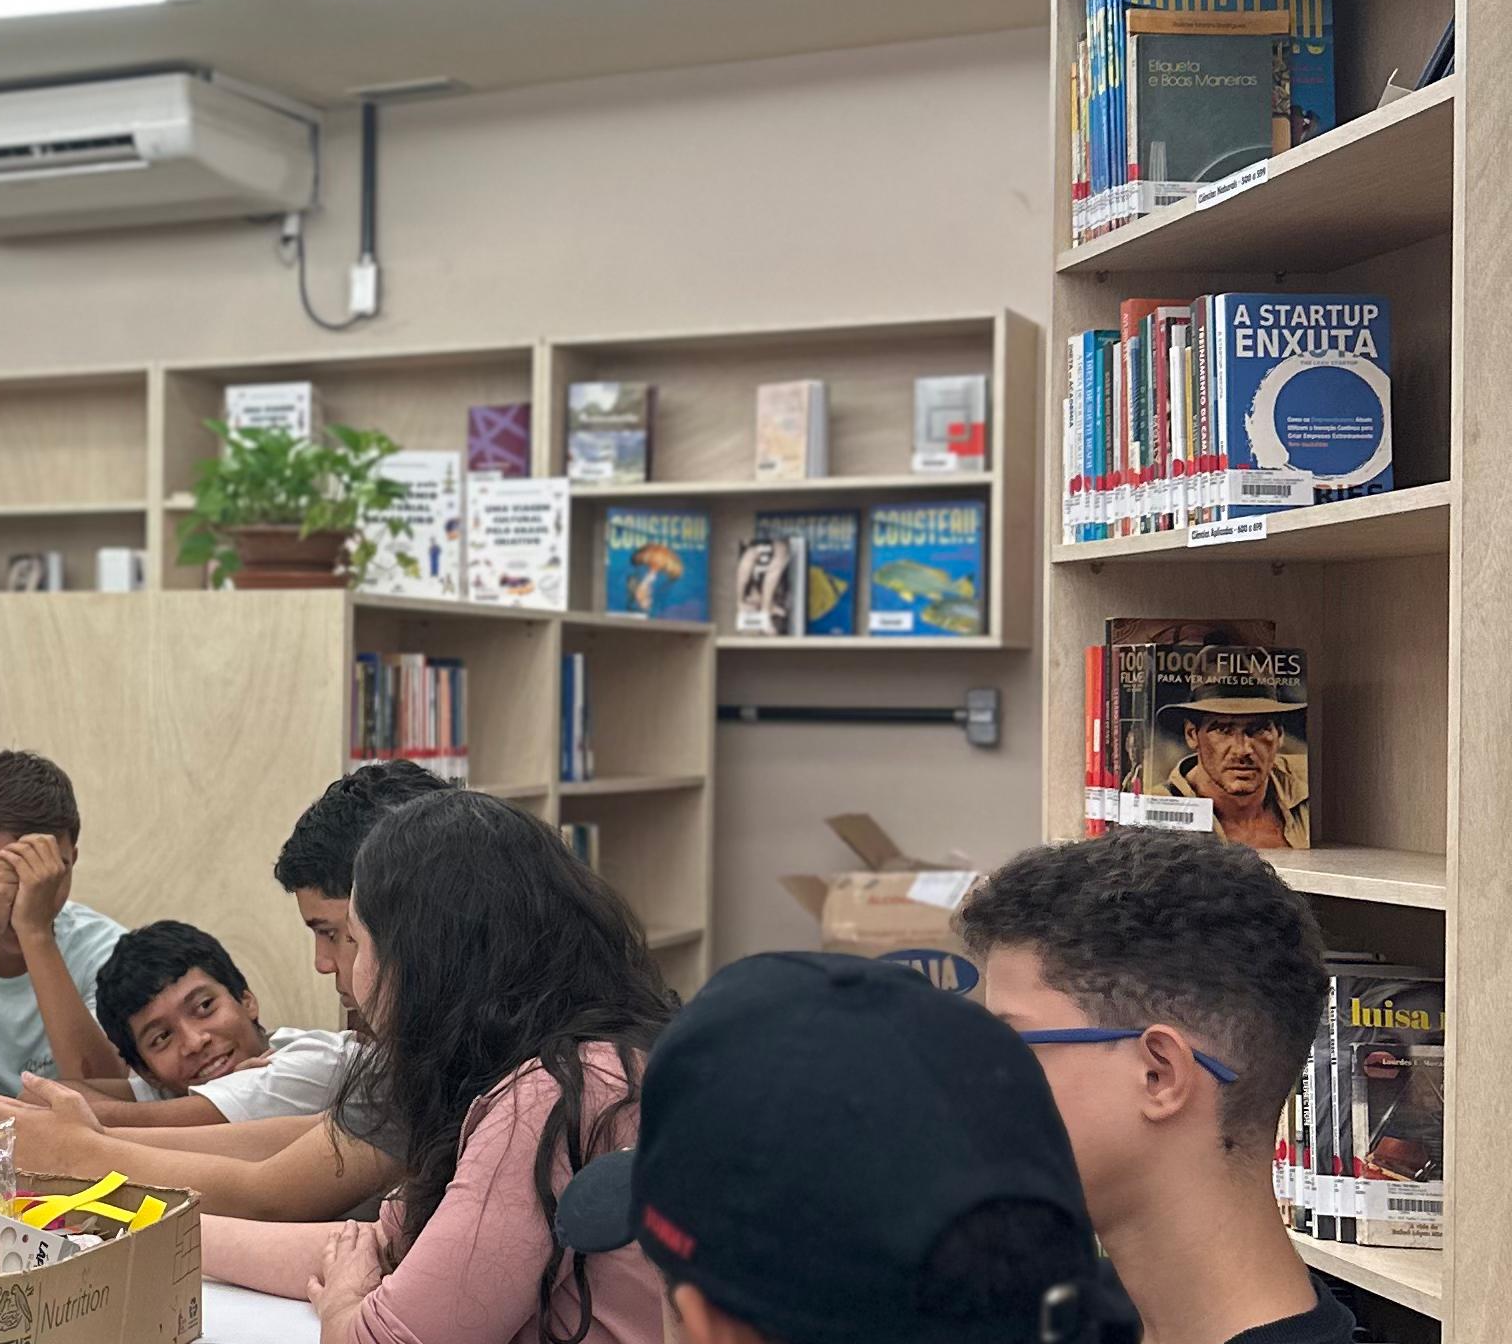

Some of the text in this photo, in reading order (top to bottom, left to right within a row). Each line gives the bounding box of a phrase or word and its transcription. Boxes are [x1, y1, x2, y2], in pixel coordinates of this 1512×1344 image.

[1148, 74, 1257, 87] e Boas Maneiras
[1149, 59, 1200, 74] Etiqueta
[1233, 304, 1379, 327] A STARTUP
[1235, 328, 1378, 359] ENXUTA
[1198, 325, 1207, 406] TREINAMENTO
[872, 508, 978, 546] COUSTEAU
[1156, 651, 1301, 676] 1001 FILMES
[1157, 673, 1301, 687] PARA VER ANTES DE MORRER
[1351, 997, 1432, 1031] luisa
[40, 1284, 110, 1334] Nutrition
